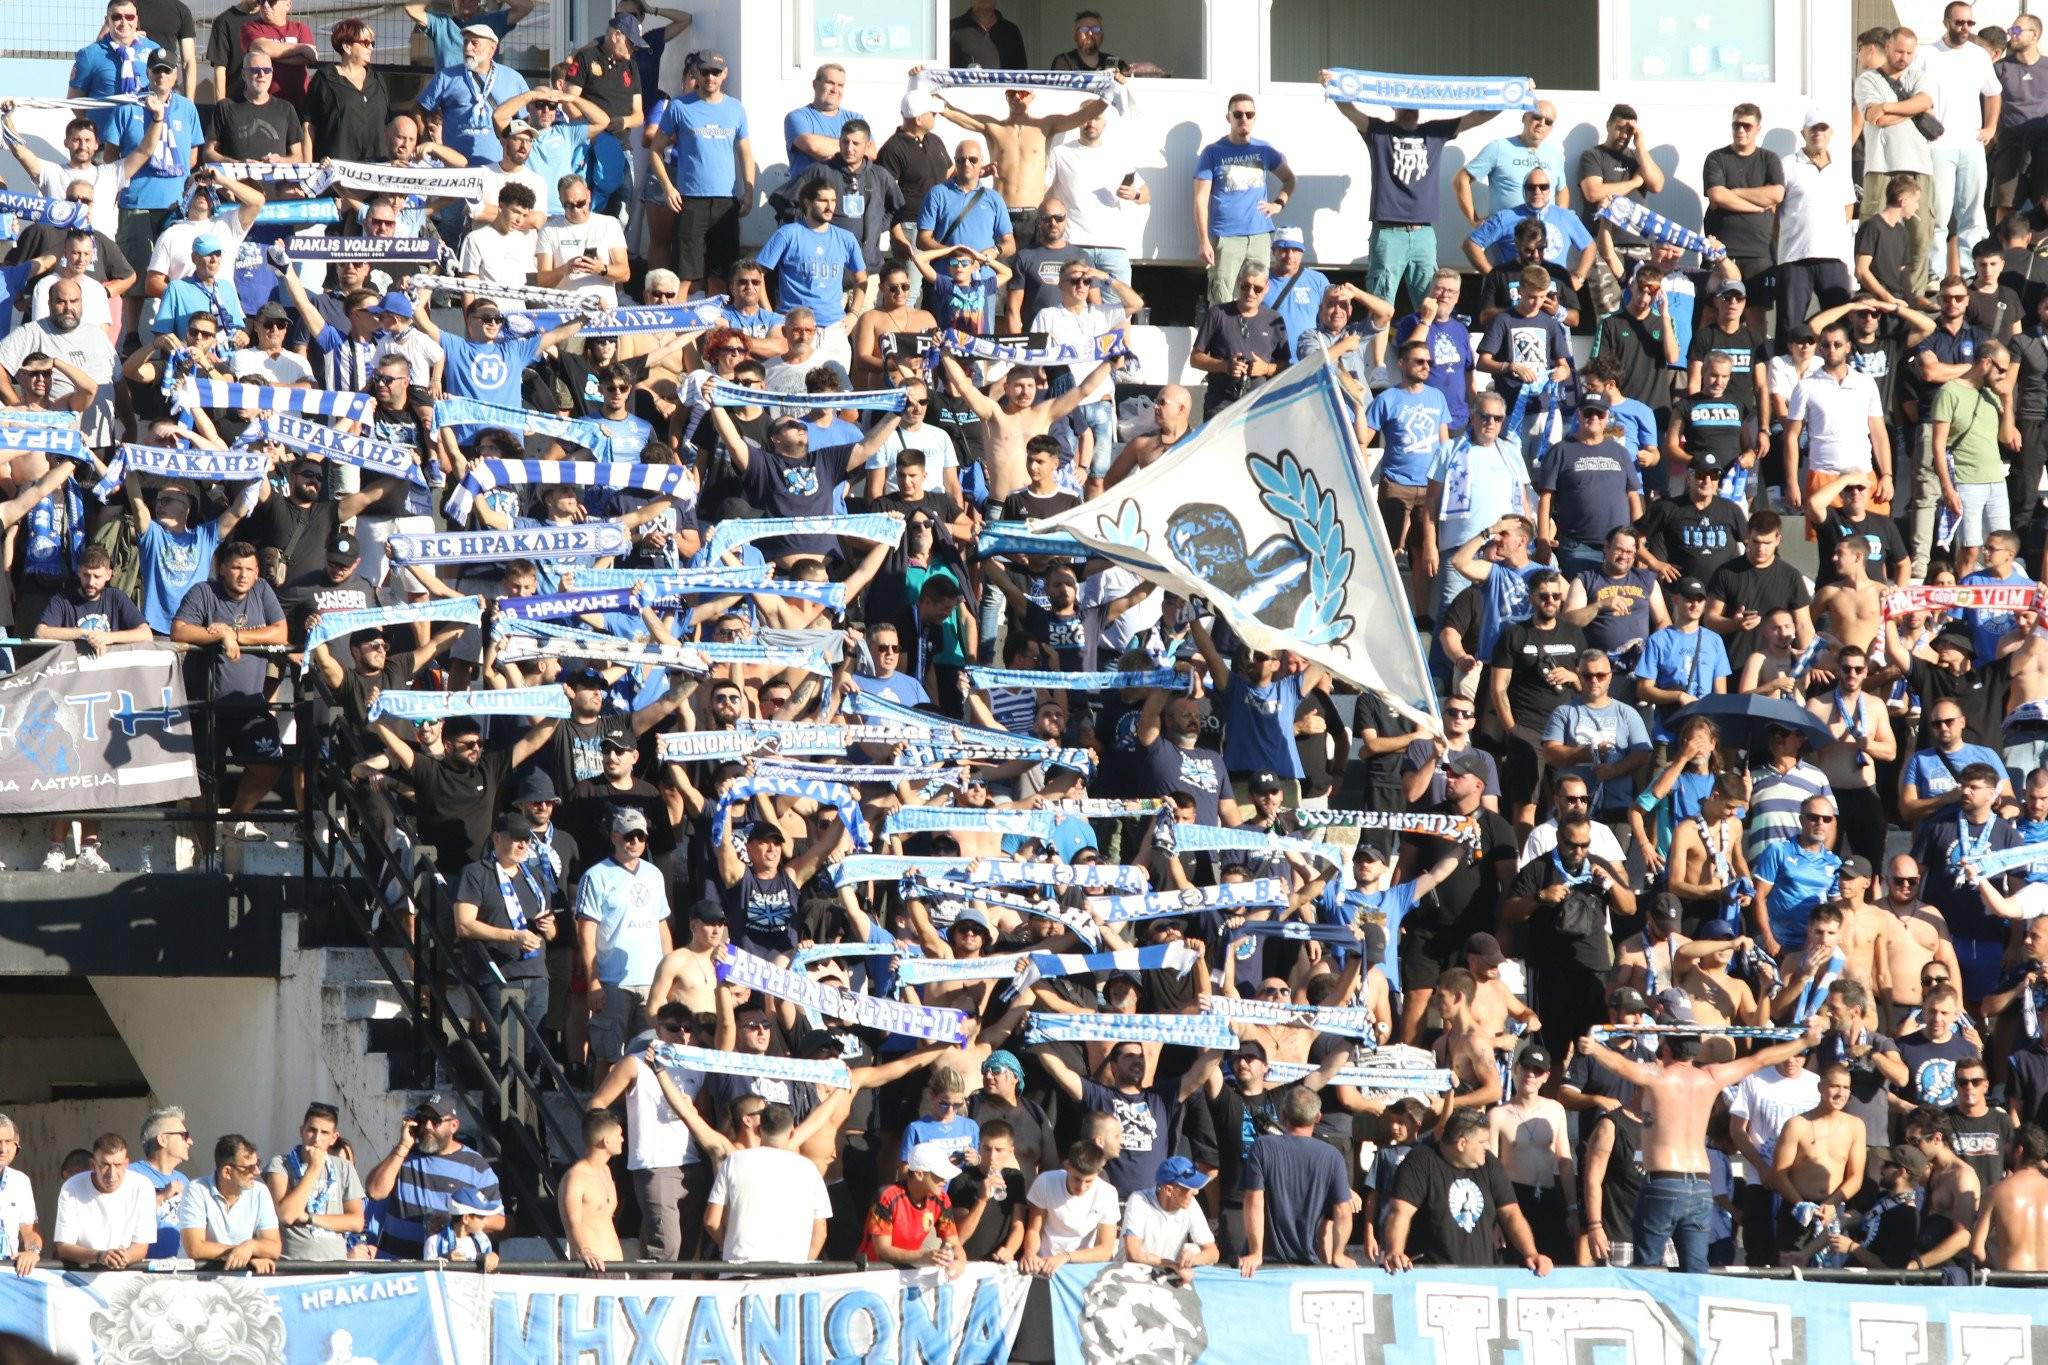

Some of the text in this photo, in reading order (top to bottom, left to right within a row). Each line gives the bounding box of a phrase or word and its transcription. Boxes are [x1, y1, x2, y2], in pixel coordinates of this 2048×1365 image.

[1375, 82, 1488, 102] ΗΡΑΚΛΗΣ
[1221, 153, 1262, 166] ΗΡΑΚΛΗΣ
[1512, 156, 1552, 171] adidas
[289, 238, 430, 253] IRAKLIS VOLLEY CLUB
[560, 310, 675, 329] ΗΚΛΗΣ
[279, 416, 406, 467] ΗΡΑΚΛΗΣ
[130, 448, 261, 472] ΗΡΑΚΛΗΣ
[459, 532, 589, 556] ΗΡΑΚΛΗΣ
[313, 589, 367, 603] UNDER
[1597, 585, 1646, 601] NEW YORK
[1981, 590, 2026, 606] VOM
[317, 600, 368, 611] ARMOUR
[526, 595, 620, 618] ΗΡΑΚΛΗΣ
[1050, 630, 1086, 646] SKG
[30, 772, 117, 792] ΛΑΤΡΕΙΑ
[627, 919, 656, 930] AUD
[731, 949, 840, 1013] ATHENS
[1067, 1013, 1226, 1026] THE REAL FEAR
[1060, 1028, 1082, 1041] IN
[1090, 1029, 1236, 1048] THESSALONIKI
[301, 1275, 420, 1312] ΗΡΑΚΛΗΣ
[490, 1275, 1010, 1365] ΜΗΧΑΝΙΩΝΑ
